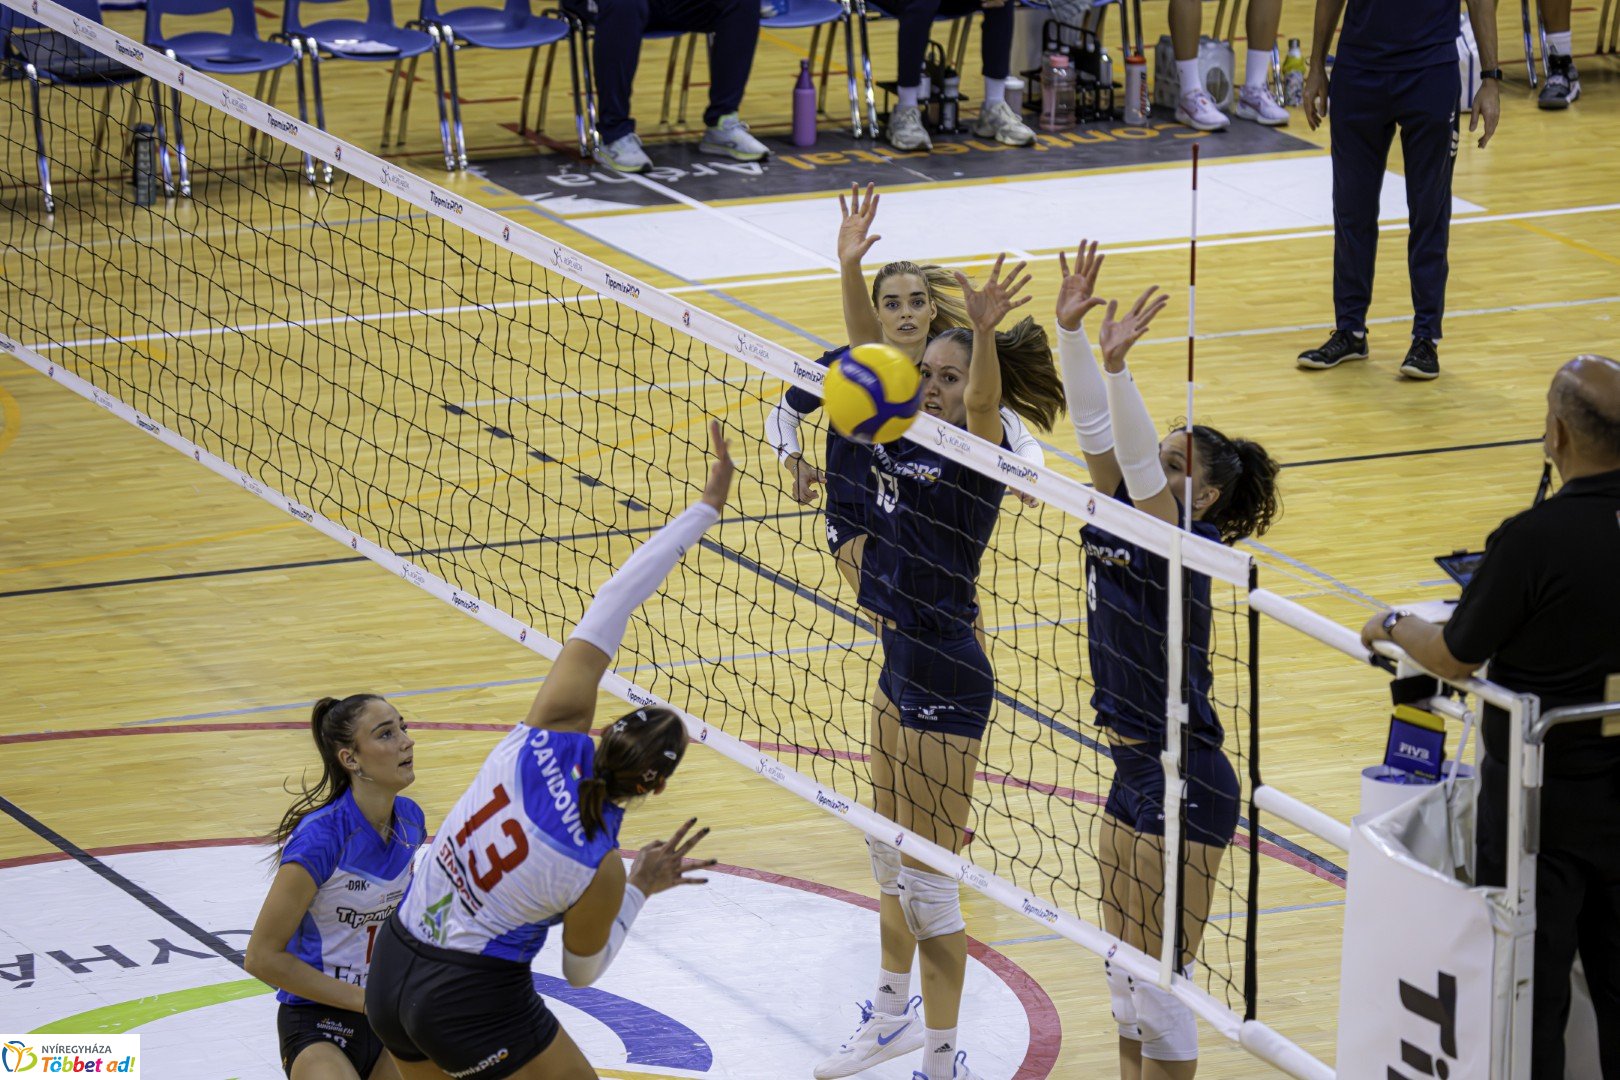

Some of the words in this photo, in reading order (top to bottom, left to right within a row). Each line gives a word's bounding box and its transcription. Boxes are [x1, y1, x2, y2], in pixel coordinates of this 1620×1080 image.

[430, 190, 464, 215] TippmixPRO
[605, 273, 640, 299] TippmixPRO
[996, 454, 1039, 484] TippmixPRO
[815, 789, 850, 816] TippmixPRO
[455, 783, 530, 893] 13
[1022, 898, 1059, 924] TippmixPRO
